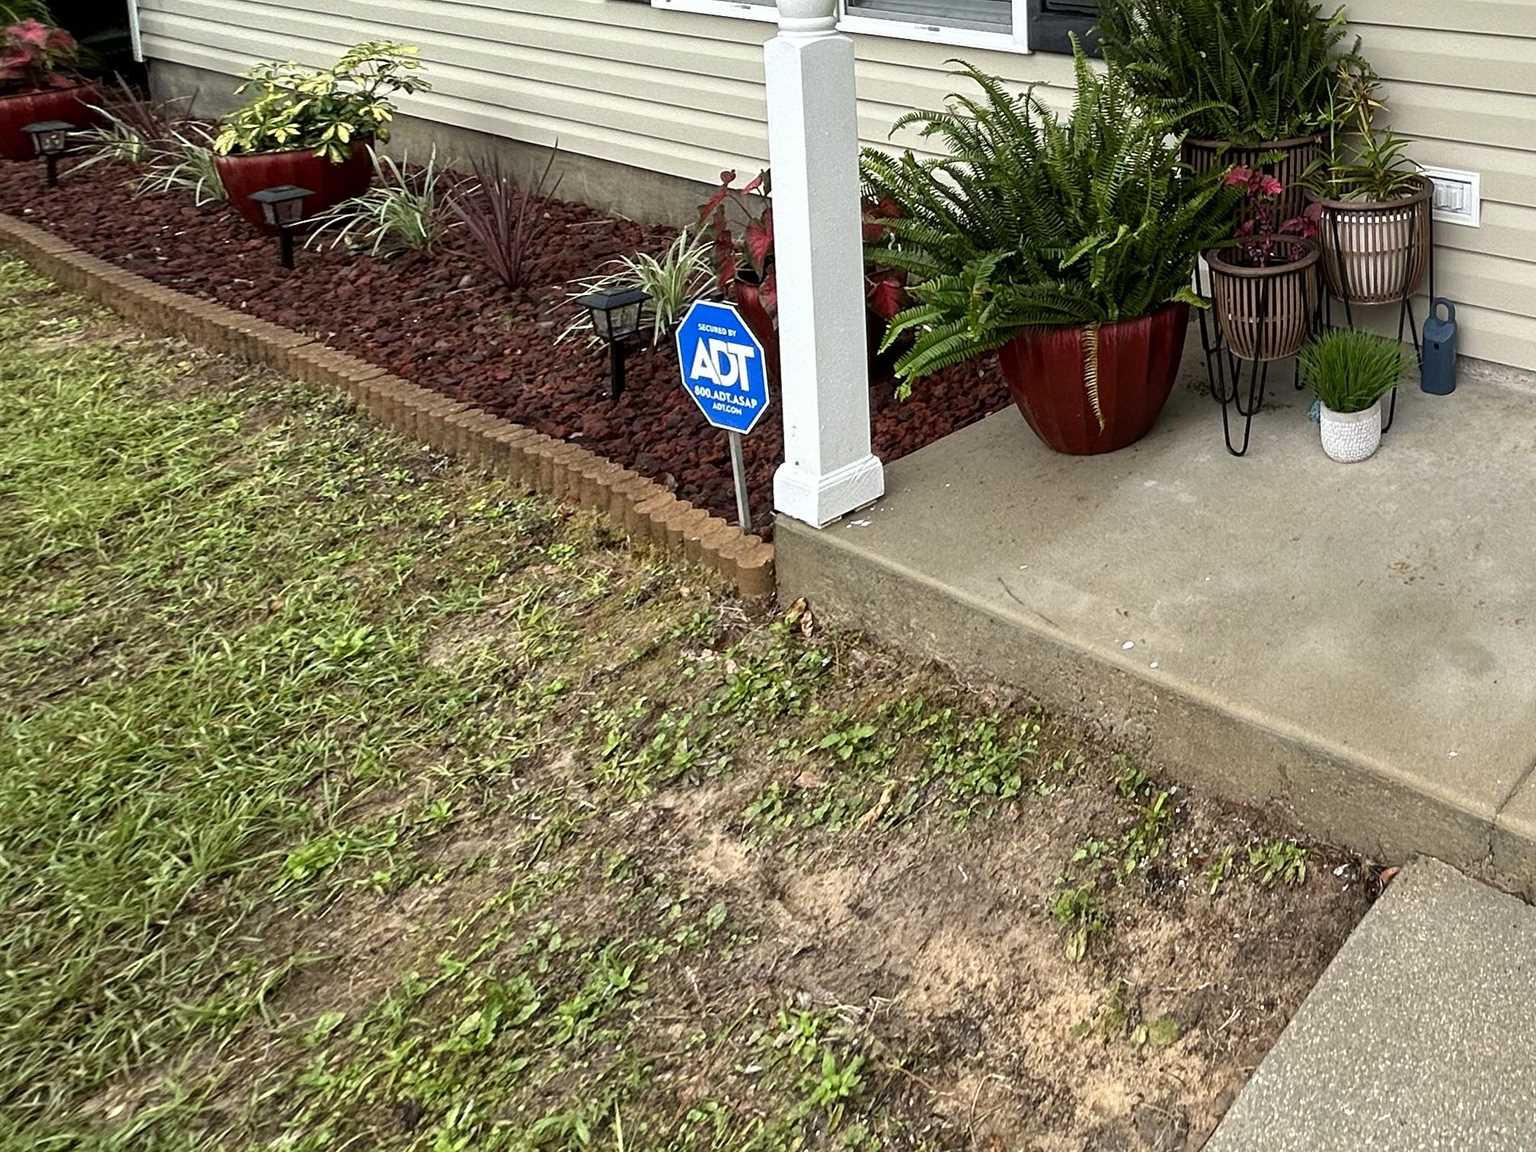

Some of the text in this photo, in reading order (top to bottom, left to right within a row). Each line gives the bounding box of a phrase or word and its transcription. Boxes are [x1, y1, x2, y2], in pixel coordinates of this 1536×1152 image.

[697, 322, 737, 337] SECURED BY
[688, 336, 755, 392] ADT
[693, 385, 758, 409] 800.ADT.ASAP
[712, 403, 743, 415] ADT.COM
